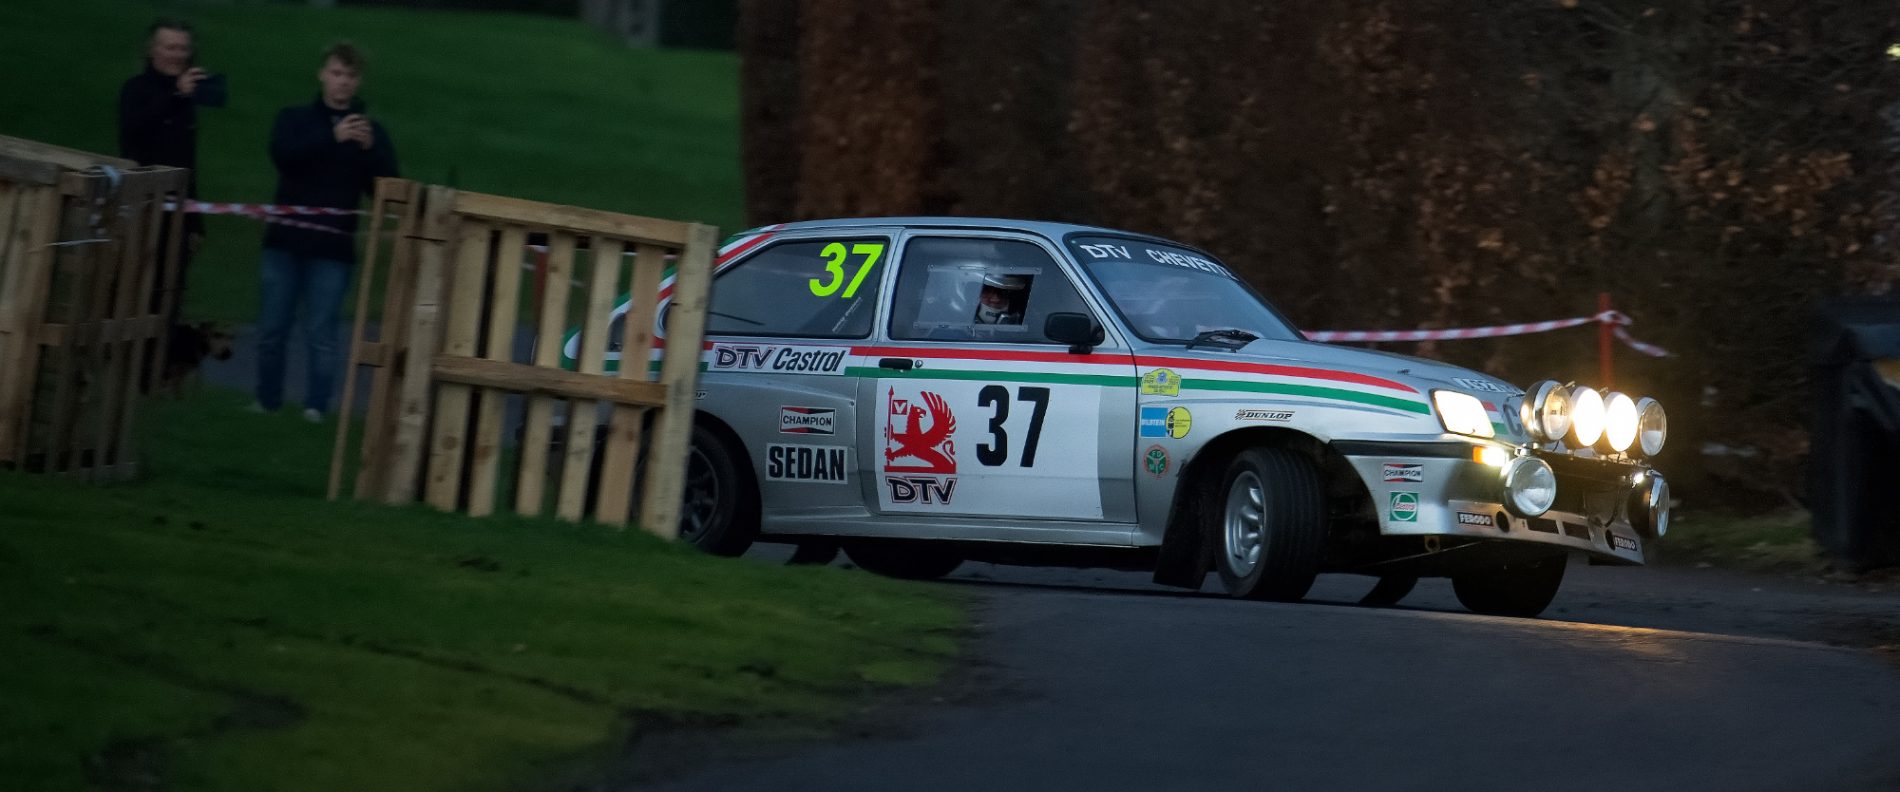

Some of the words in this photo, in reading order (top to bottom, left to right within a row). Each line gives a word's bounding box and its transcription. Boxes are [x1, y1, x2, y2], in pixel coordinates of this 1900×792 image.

[1079, 244, 1131, 259] DTV
[809, 242, 884, 298] 37
[714, 346, 774, 369] DTV
[773, 347, 845, 372] Castrol
[783, 415, 832, 426] CHAMPION
[976, 384, 1050, 468] 37
[1246, 412, 1293, 420] DUNLOP
[769, 446, 844, 481] SEDAN
[1384, 469, 1421, 477] CHAMPION
[885, 476, 957, 505] DTV
